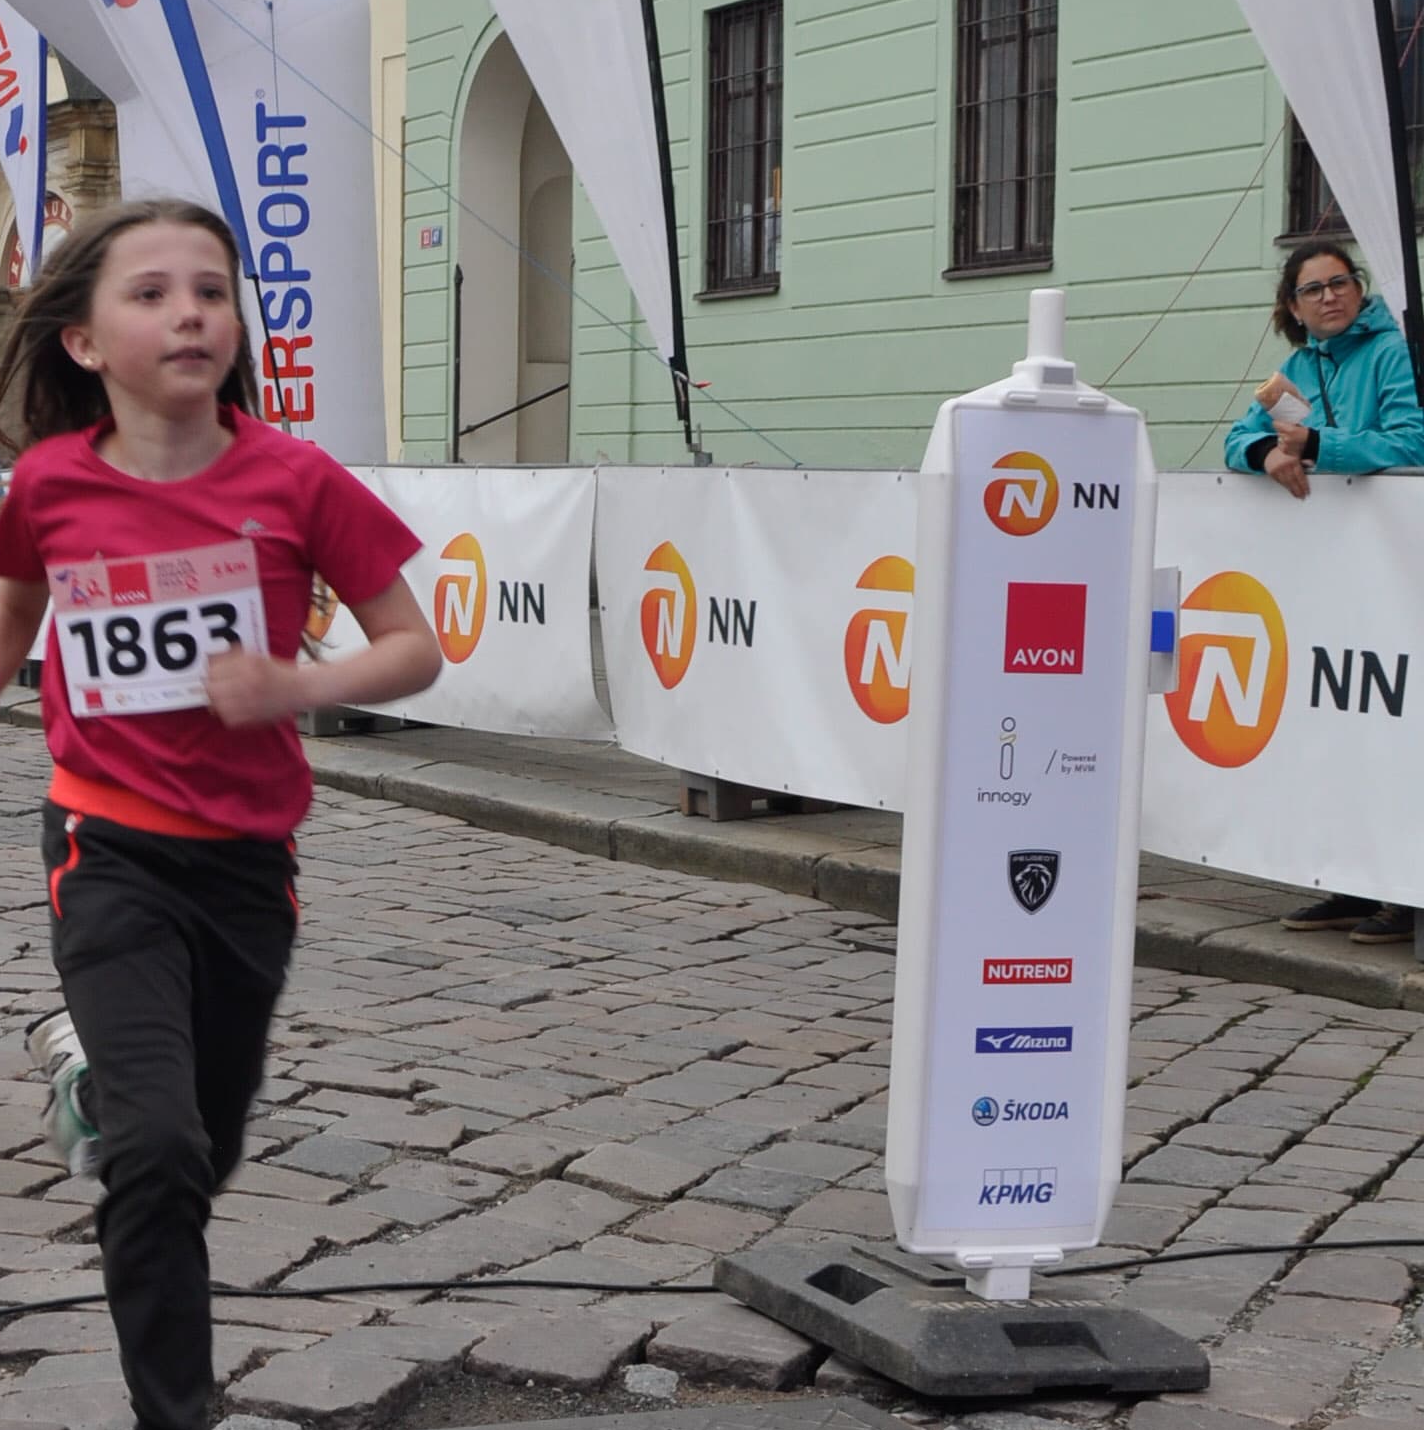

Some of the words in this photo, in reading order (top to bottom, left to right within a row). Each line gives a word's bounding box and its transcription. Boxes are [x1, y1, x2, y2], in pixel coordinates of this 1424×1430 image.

[256, 102, 315, 443] ERSPORT
[1073, 483, 1119, 509] NN
[499, 581, 545, 625] NN
[708, 596, 756, 647] NN
[69, 602, 242, 677] 1863
[1013, 649, 1075, 666] AVON
[1310, 646, 1408, 718] NN
[1061, 753, 1097, 762] Powered
[1061, 764, 1073, 774] by
[977, 787, 1032, 806] innogy
[988, 964, 1069, 979] NUTREND
[1002, 1099, 1069, 1121] ŠKODA
[978, 1182, 1054, 1205] KPMG
